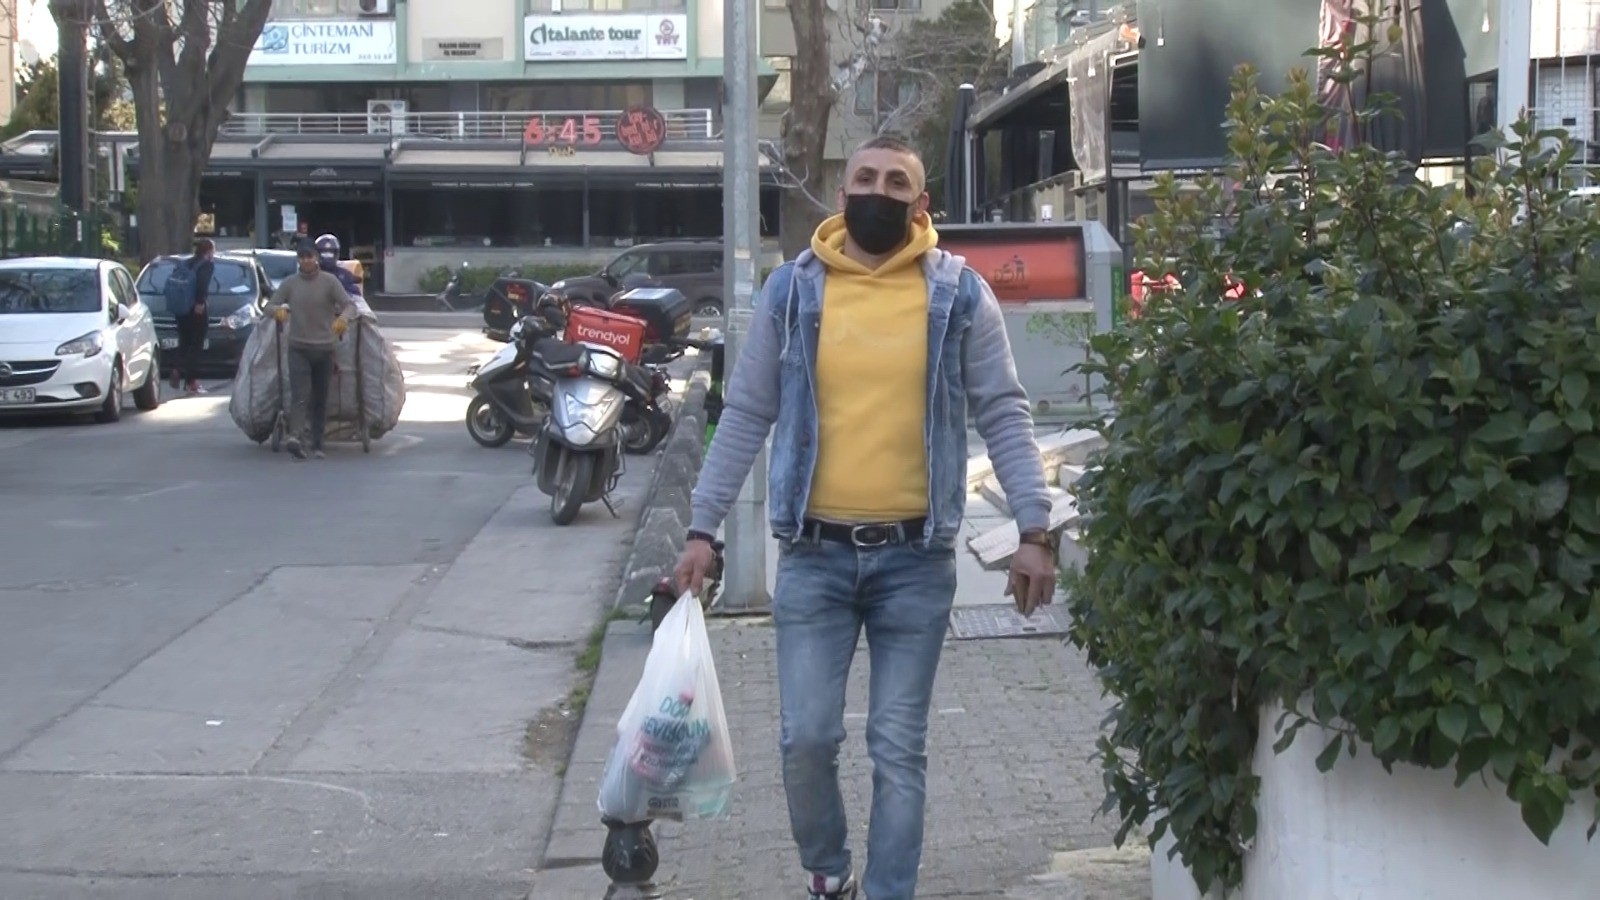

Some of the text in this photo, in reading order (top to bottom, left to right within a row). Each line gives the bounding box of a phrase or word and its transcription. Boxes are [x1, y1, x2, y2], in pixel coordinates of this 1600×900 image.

[291, 22, 373, 39] ÇİNTEMANİ
[608, 26, 642, 41] tour
[293, 41, 351, 55] TURİZM
[524, 116, 603, 145] 6:45
[577, 324, 630, 345] trendyol
